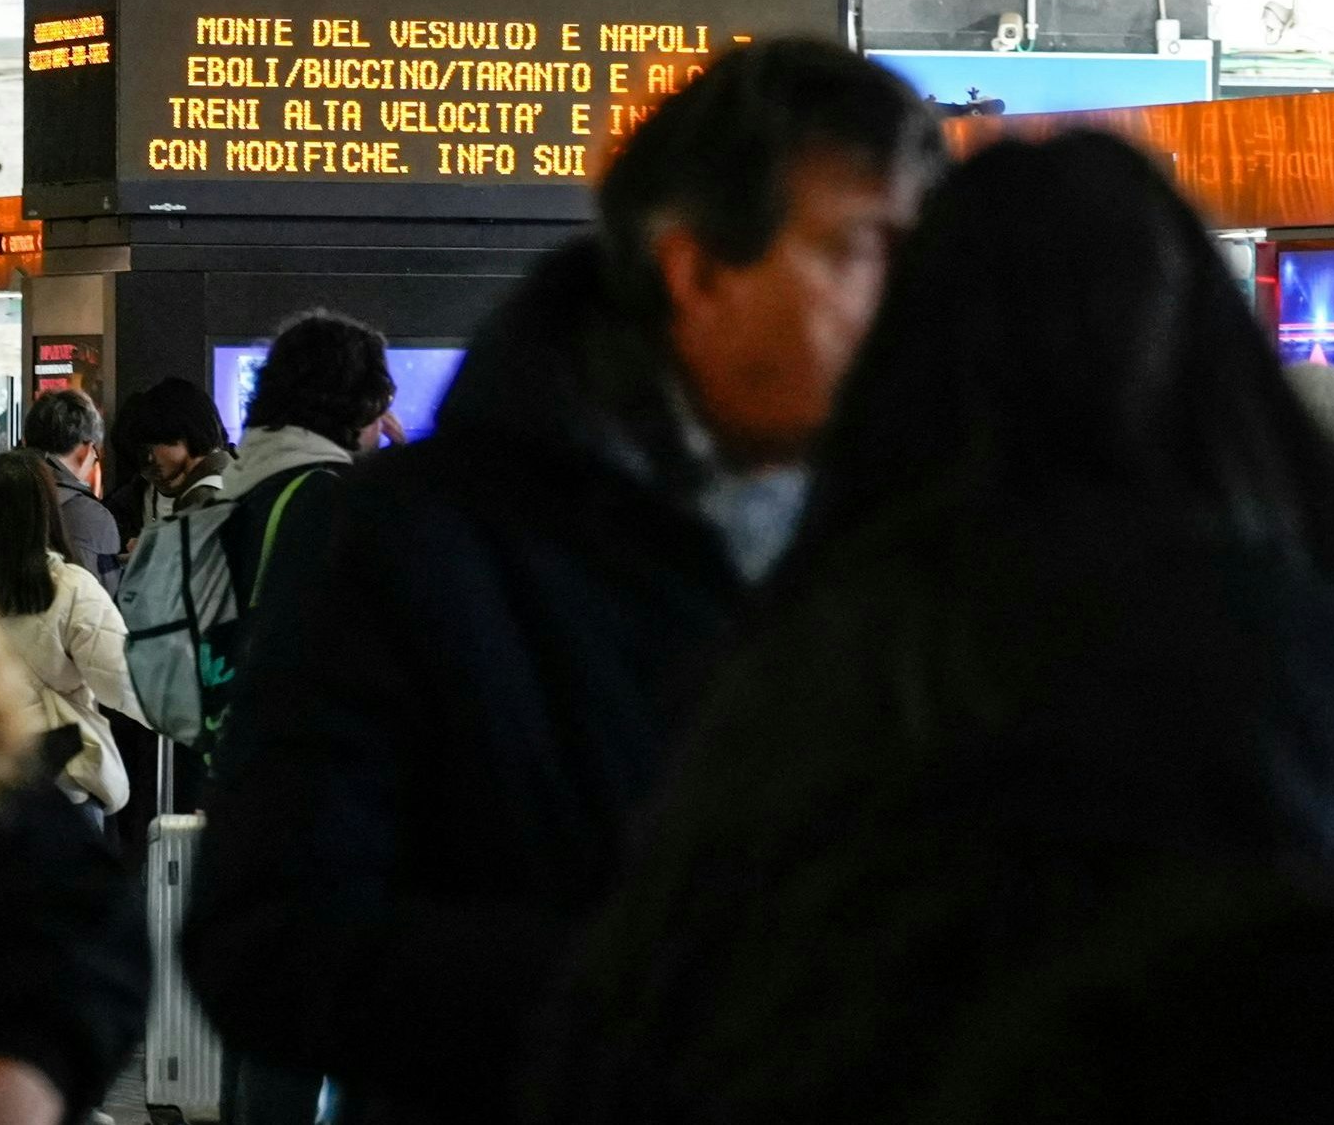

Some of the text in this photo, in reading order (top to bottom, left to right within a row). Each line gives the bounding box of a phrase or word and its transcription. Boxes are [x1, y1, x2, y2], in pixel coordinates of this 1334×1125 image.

[197, 17, 293, 46] MONTE
[313, 19, 370, 47] DEL
[390, 21, 537, 50] VESUVIO)
[562, 24, 581, 51] E
[600, 24, 709, 53] NAPOLI
[188, 57, 629, 93] EBOLI/BUCCINO/TARANTO E
[169, 98, 591, 135] TRENI ALTA VELOCITA' E
[149, 139, 586, 176] CON MODIFICHE. INFO SUI
